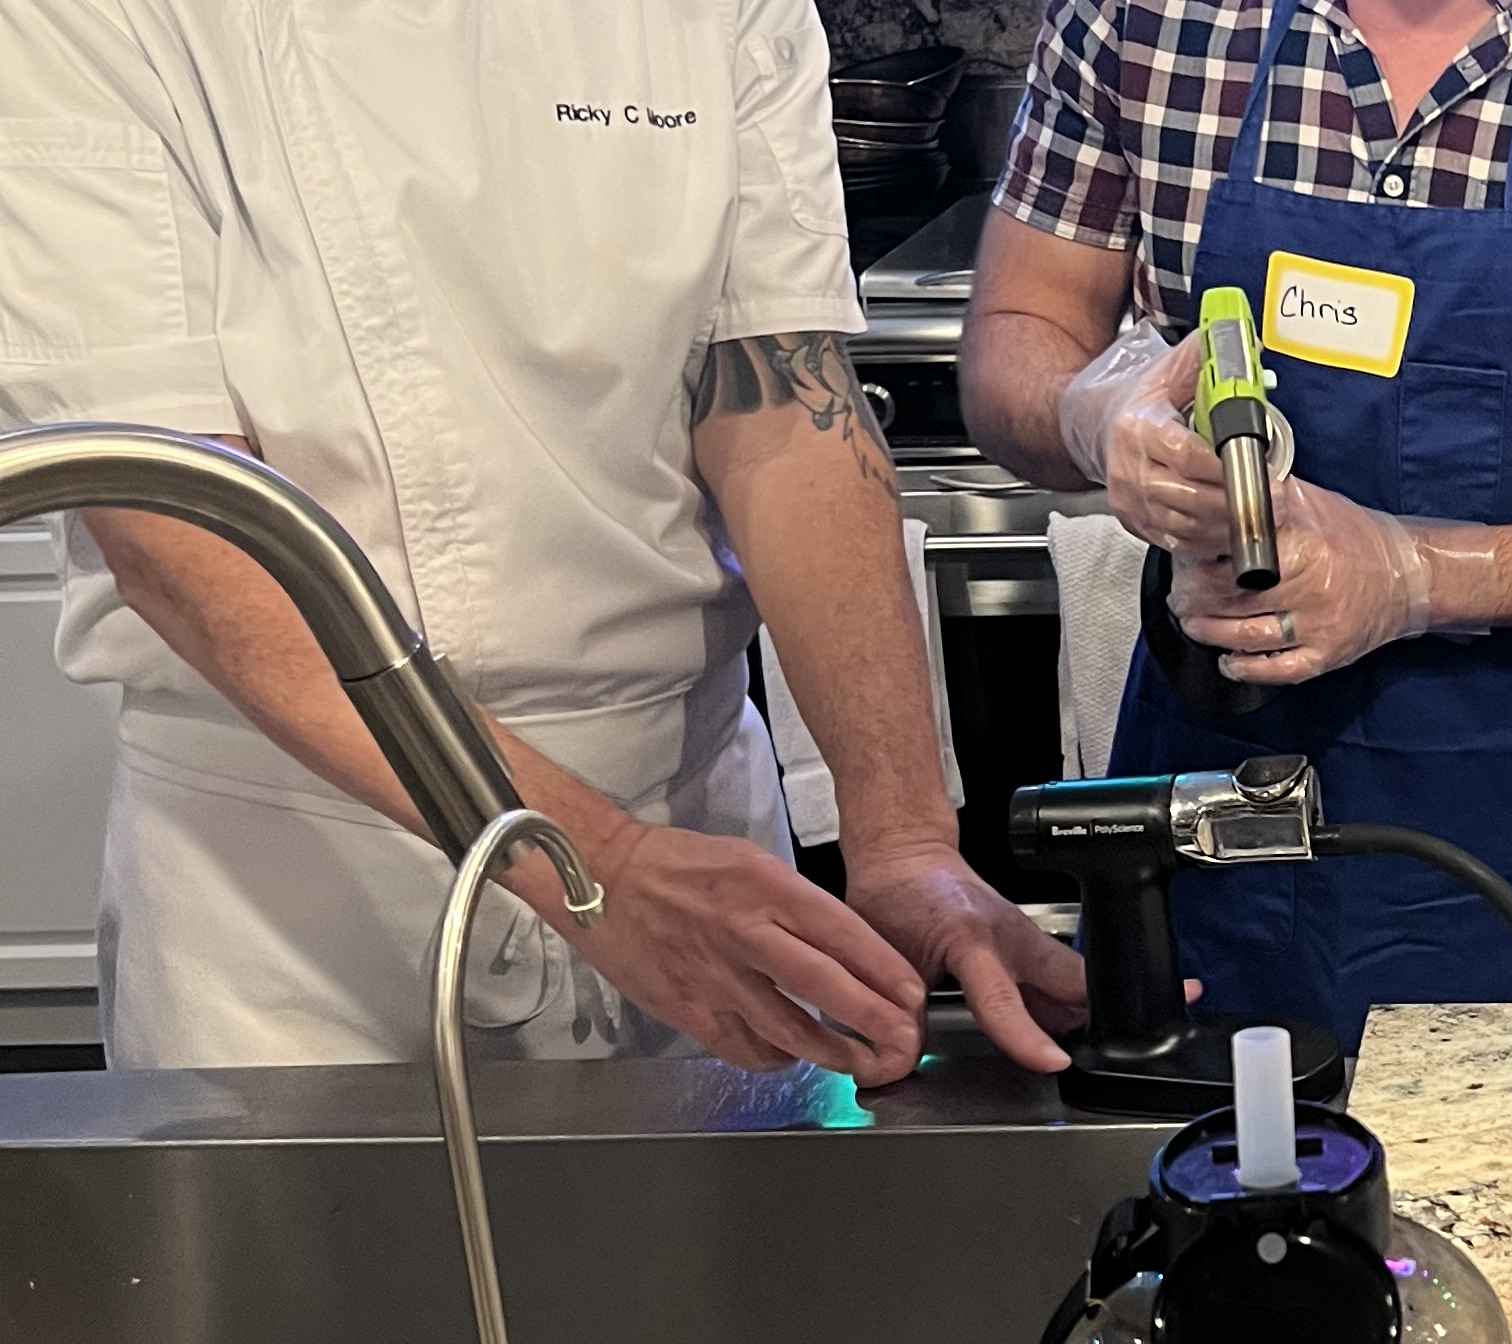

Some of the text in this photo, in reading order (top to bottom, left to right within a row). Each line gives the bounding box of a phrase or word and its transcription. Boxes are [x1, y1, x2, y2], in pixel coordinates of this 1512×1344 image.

[556, 103, 611, 127] Ricky
[624, 104, 640, 124] C
[1280, 285, 1359, 327] Chris
